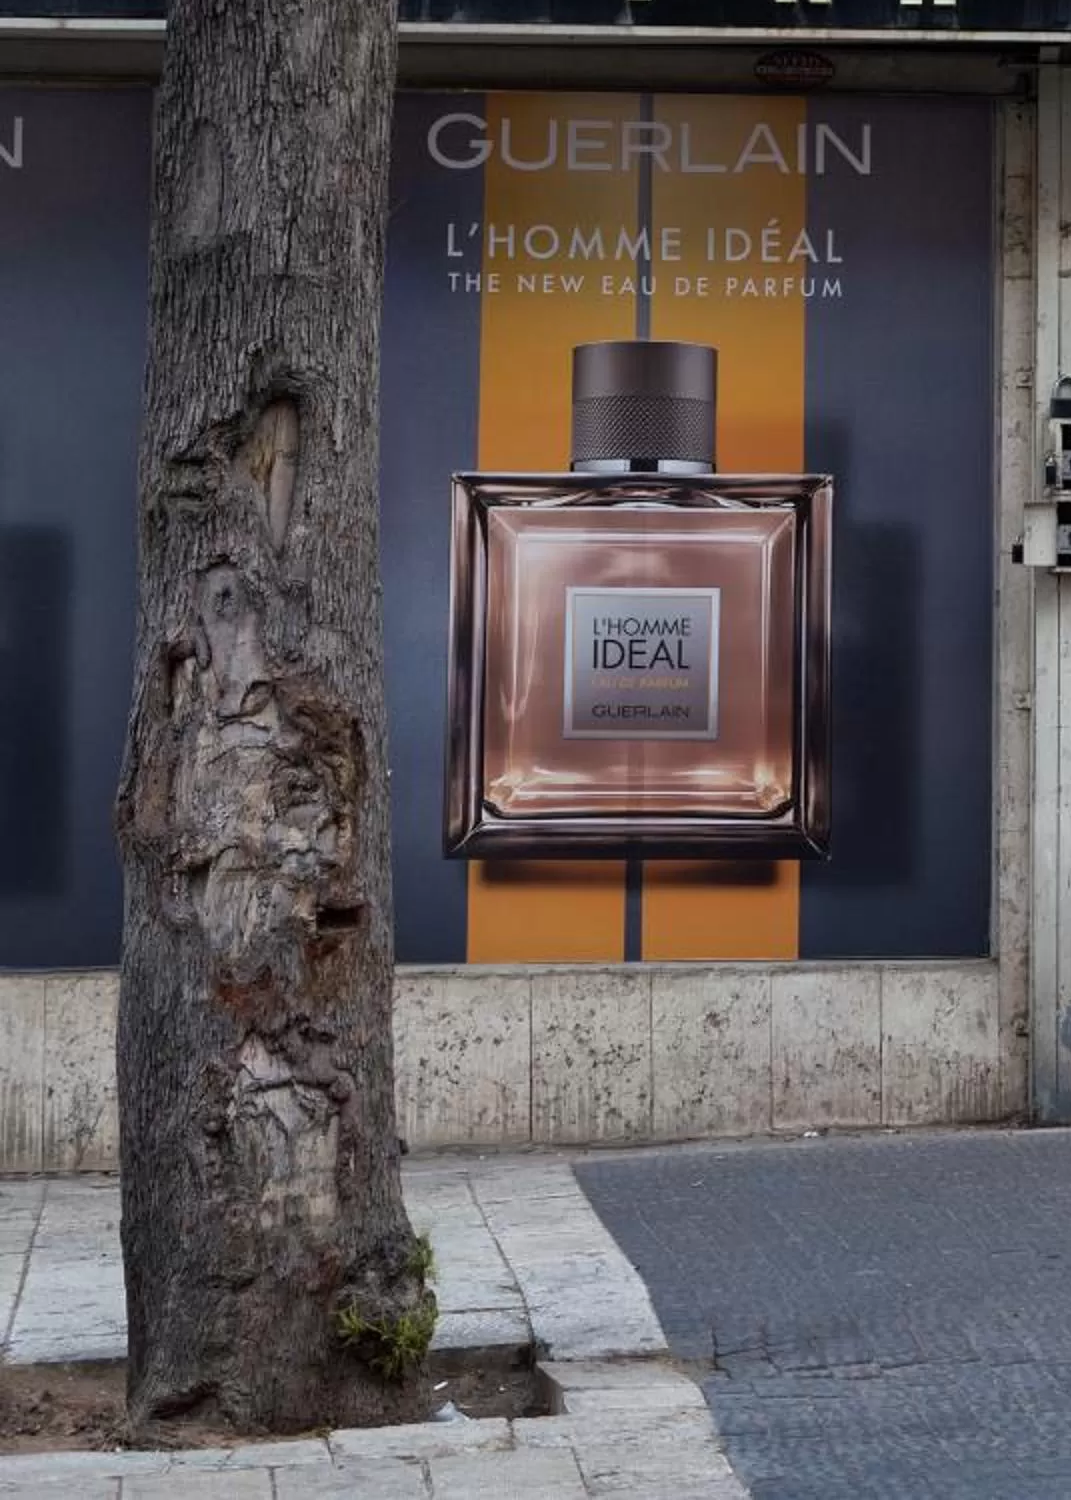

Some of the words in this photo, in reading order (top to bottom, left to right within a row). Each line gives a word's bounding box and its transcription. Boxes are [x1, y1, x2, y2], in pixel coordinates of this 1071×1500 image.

[426, 112, 871, 175] GUERLAIN
[447, 222, 682, 262] L'HOMME
[706, 218, 844, 264] IDÉAL
[448, 271, 501, 293] THE
[517, 273, 584, 294] NEW
[601, 274, 657, 296] EAU
[674, 275, 709, 296] DE
[725, 276, 843, 298] PARFUM
[592, 617, 692, 637] L'HOMME
[592, 639, 691, 669] IDEAL
[591, 705, 690, 719] GUERLAIN
